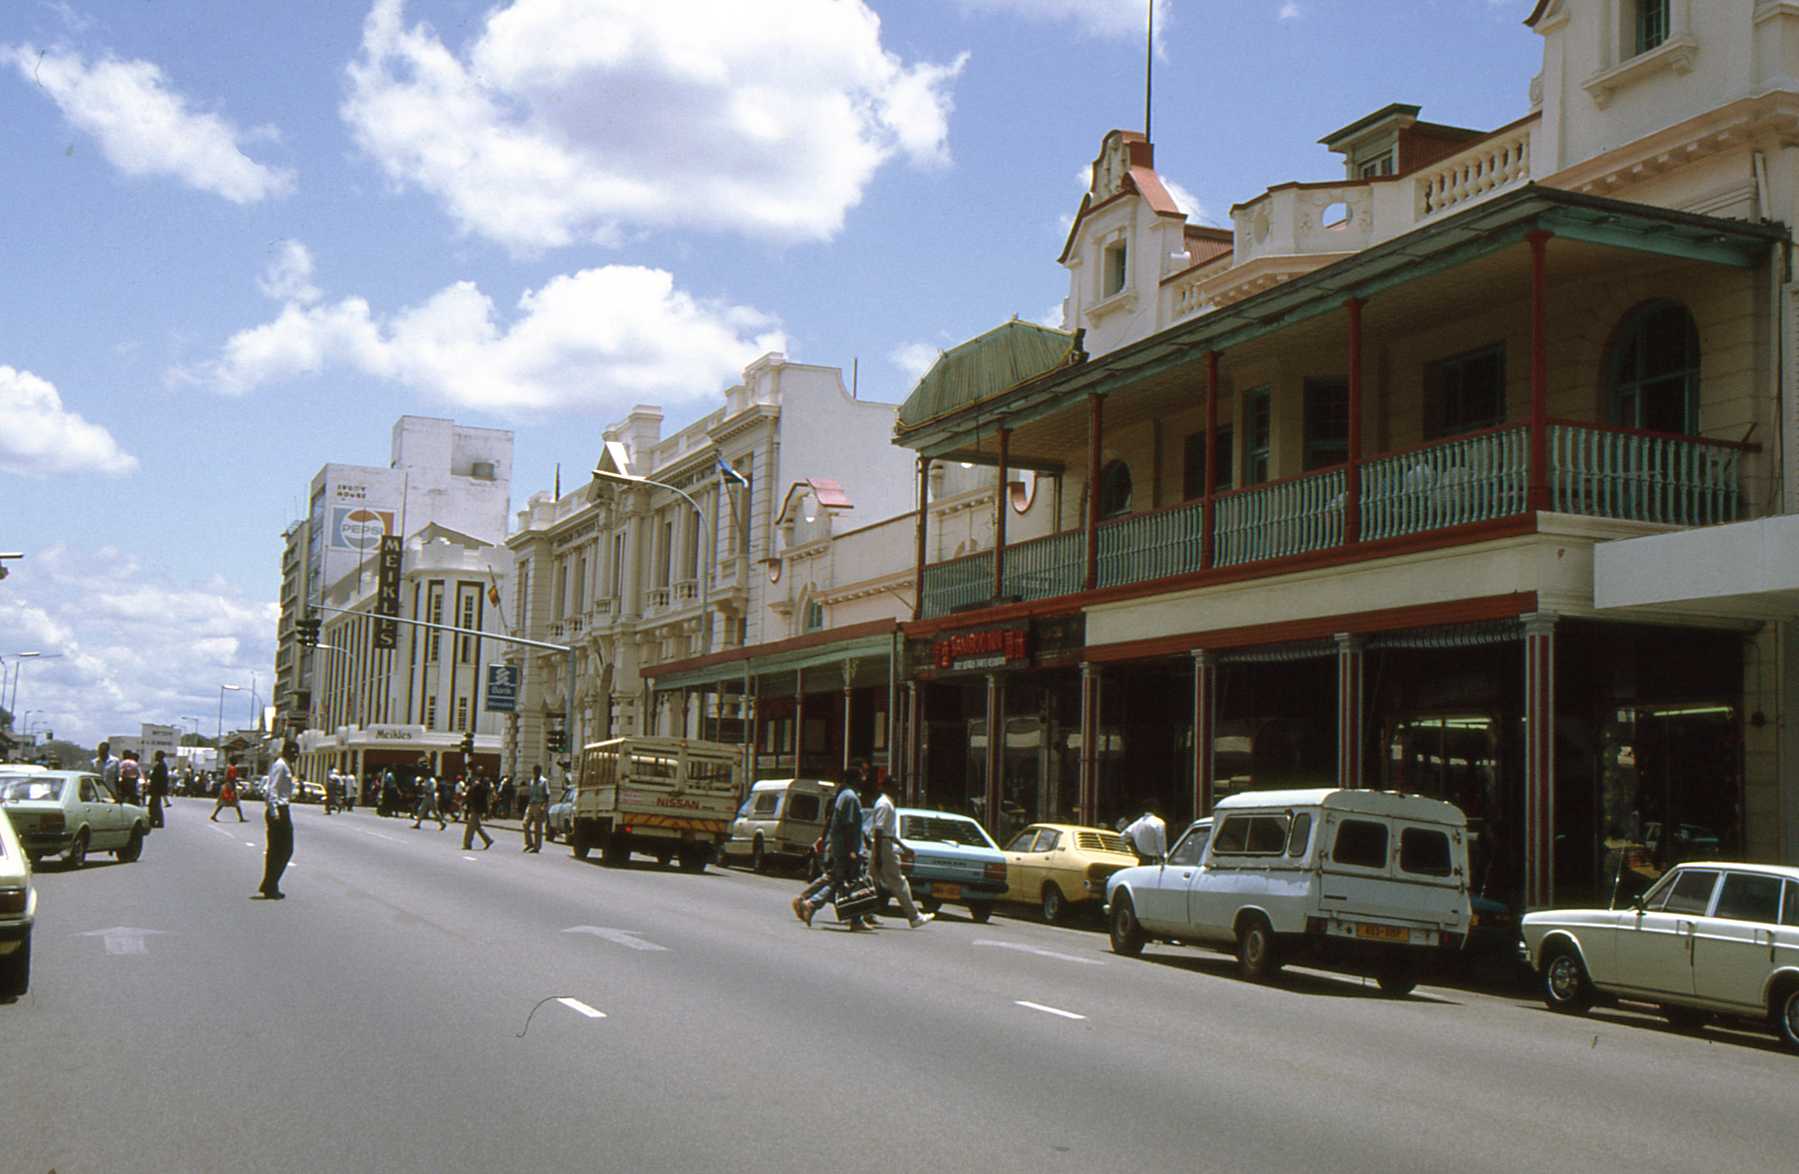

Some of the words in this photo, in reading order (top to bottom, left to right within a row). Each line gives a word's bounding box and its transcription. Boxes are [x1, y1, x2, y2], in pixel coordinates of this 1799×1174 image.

[342, 523, 384, 535] PEPSI
[381, 538, 400, 645] MEIKLES
[375, 729, 412, 740] Meikles
[656, 796, 699, 810] NISSAN
